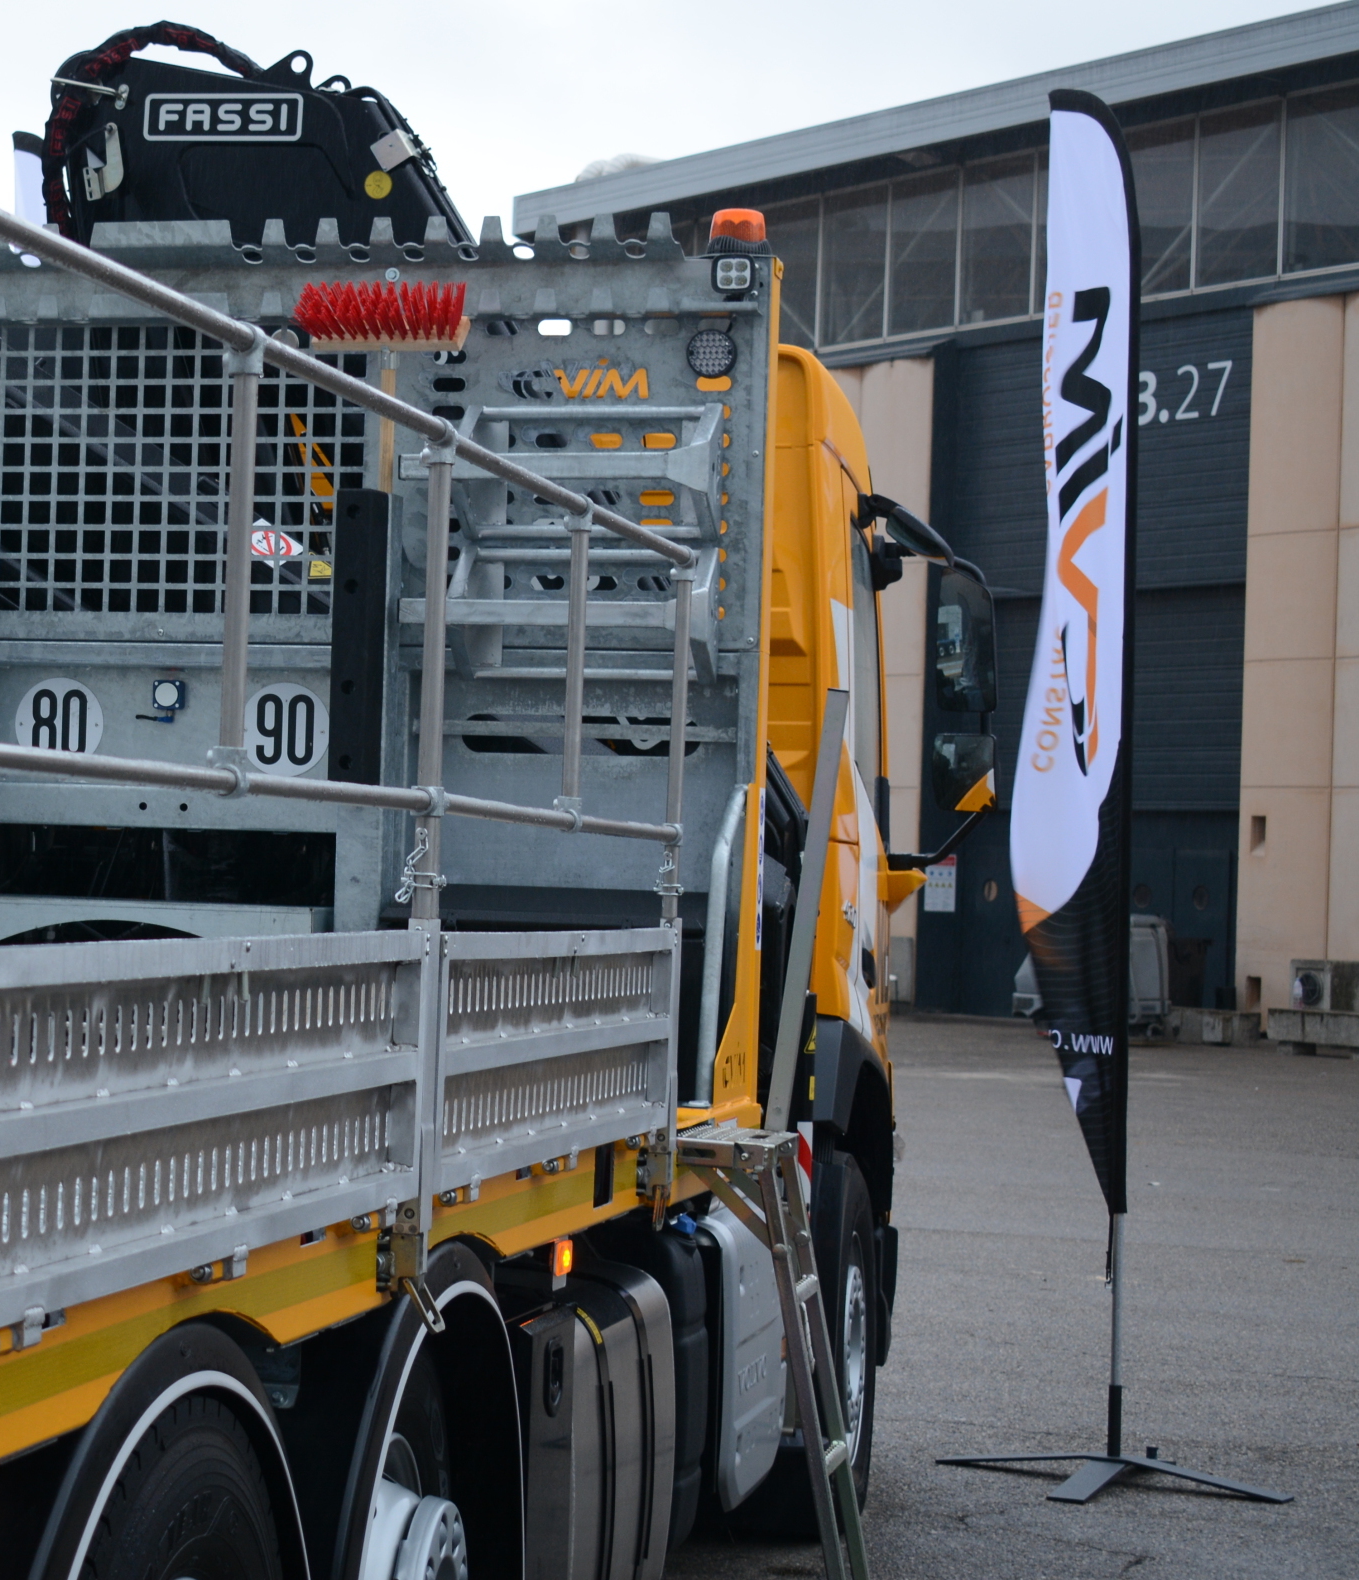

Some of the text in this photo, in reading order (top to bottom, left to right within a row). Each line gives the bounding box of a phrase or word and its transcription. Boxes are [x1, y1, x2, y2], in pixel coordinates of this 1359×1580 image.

[158, 103, 288, 131] FASSI
[32, 689, 88, 753] 80
[256, 693, 315, 766] 90
